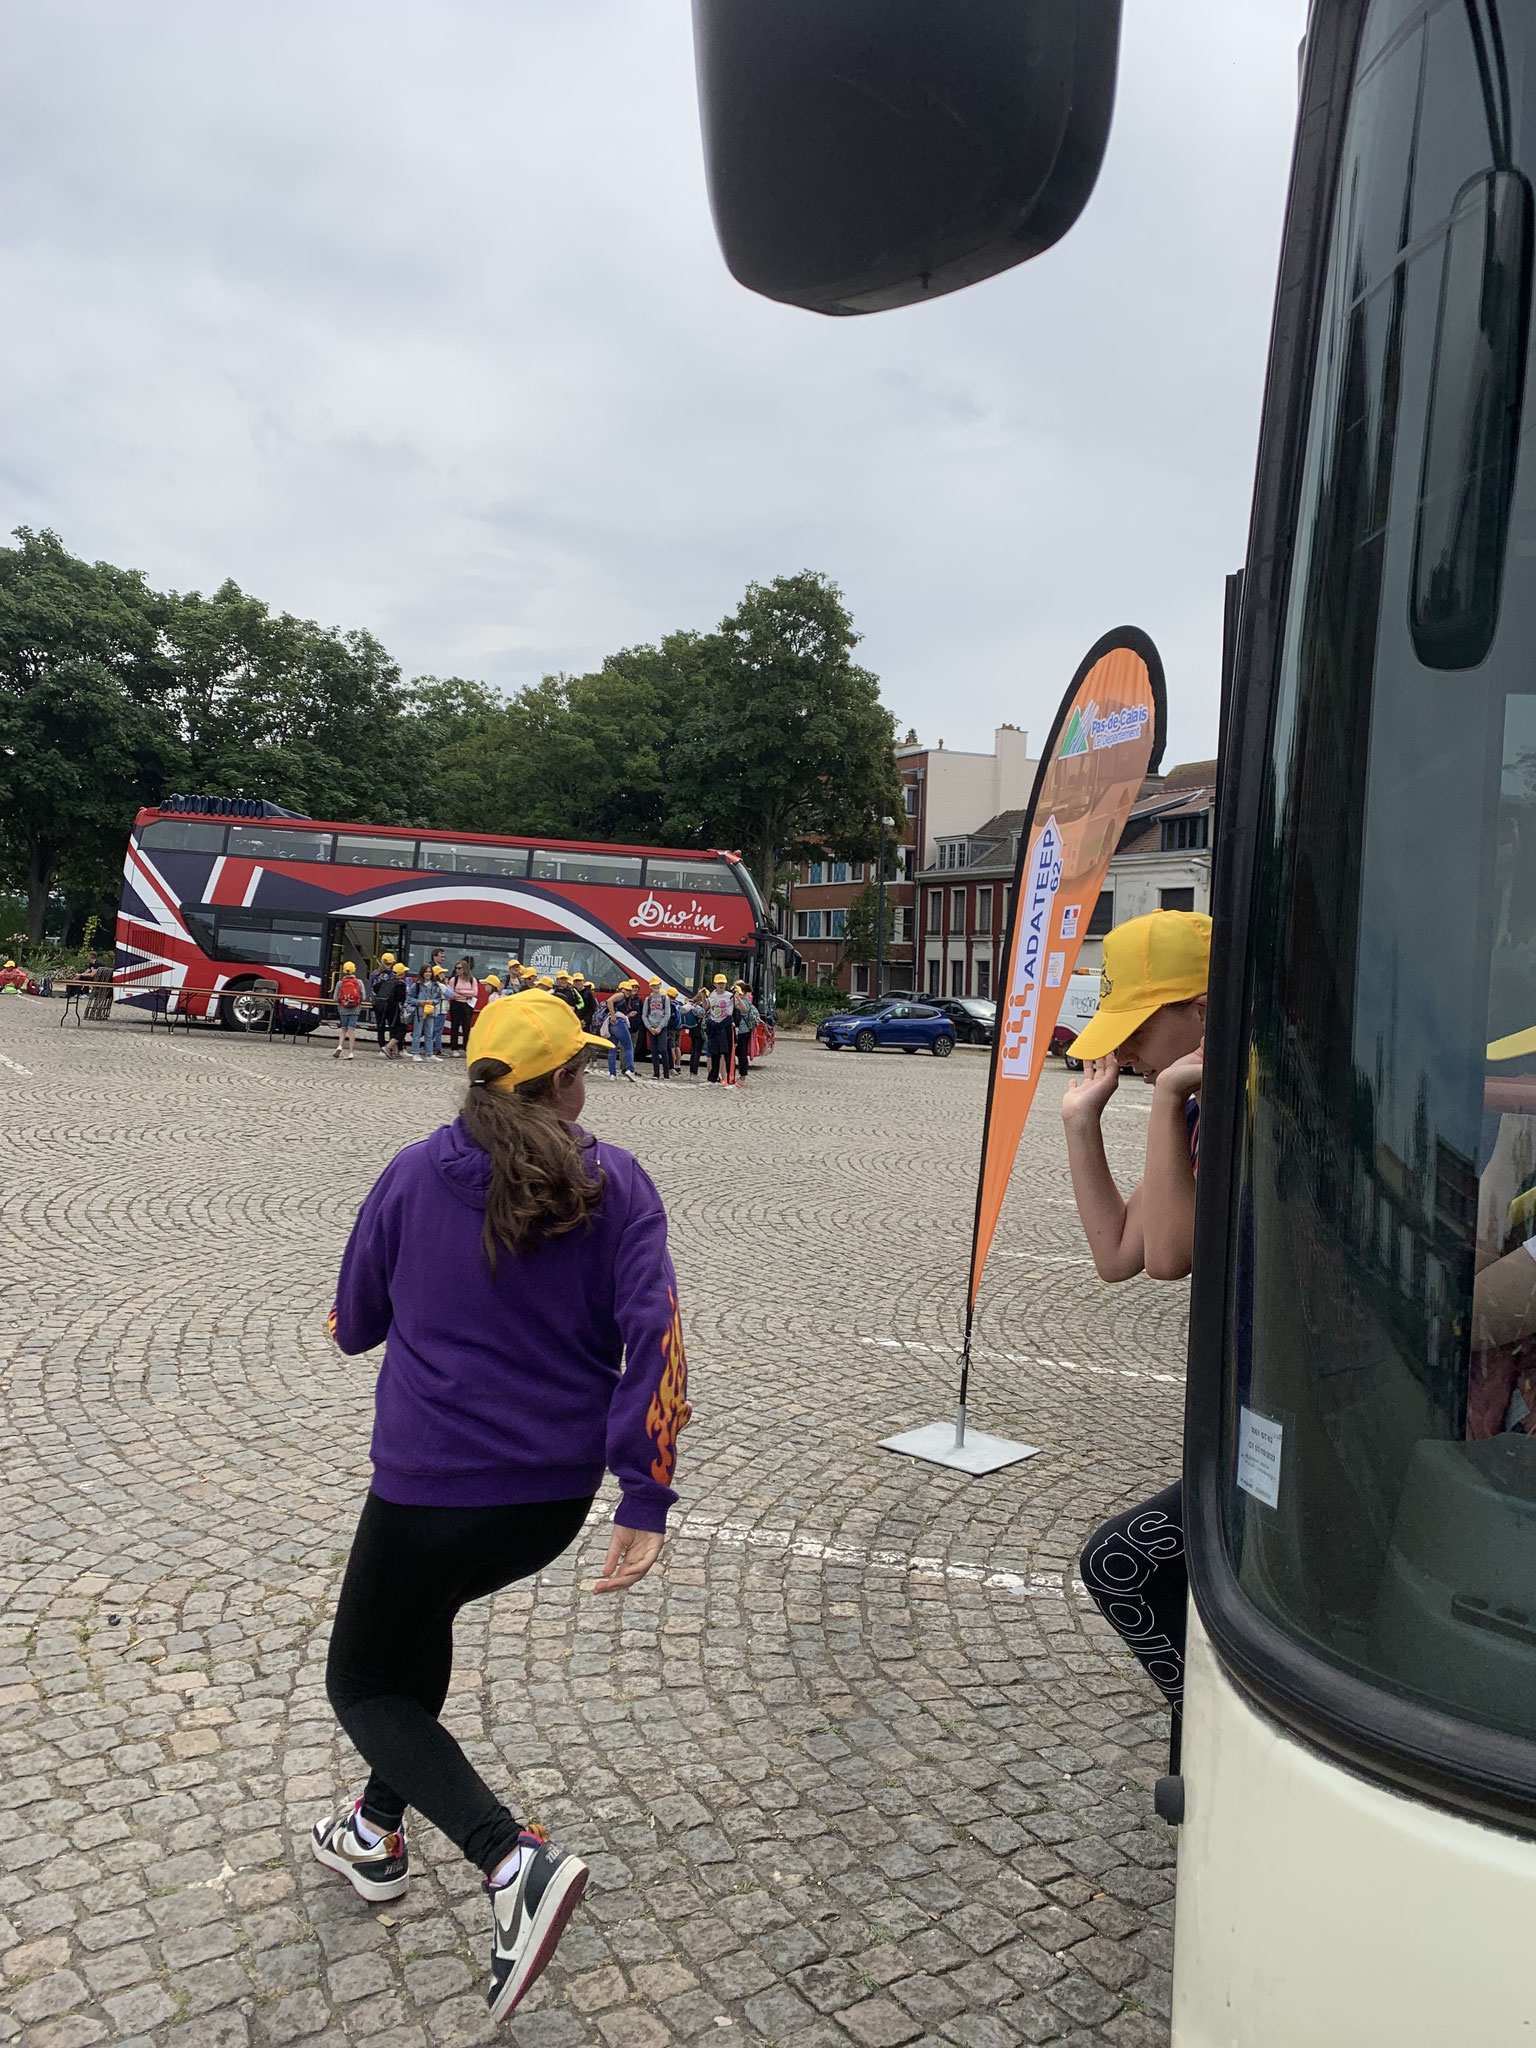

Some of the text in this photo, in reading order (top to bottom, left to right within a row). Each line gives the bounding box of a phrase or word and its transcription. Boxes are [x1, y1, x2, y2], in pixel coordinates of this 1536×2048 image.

[1092, 705, 1148, 736] Pas-de-Calais
[1051, 860, 1063, 891] 62
[1024, 829, 1055, 979] ADATEEP
